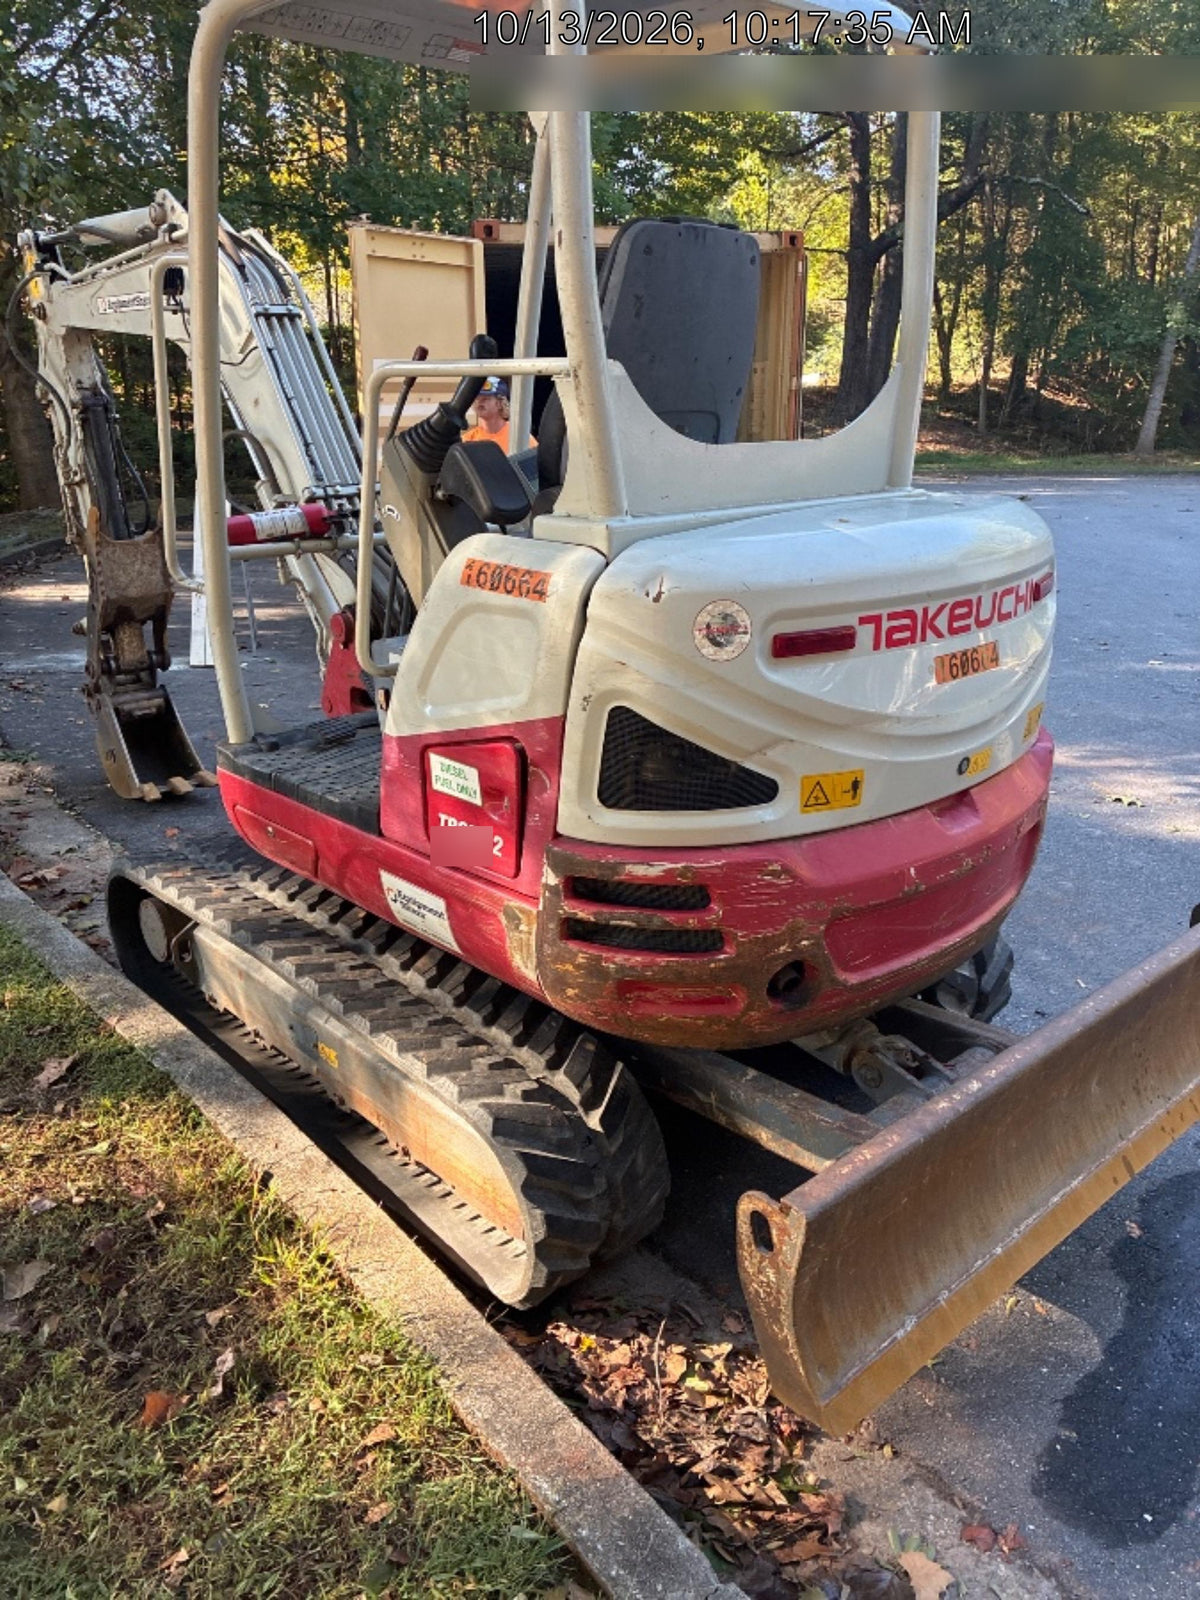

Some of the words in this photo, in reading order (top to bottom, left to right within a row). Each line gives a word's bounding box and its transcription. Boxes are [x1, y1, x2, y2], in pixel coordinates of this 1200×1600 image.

[440, 761, 469, 781] DIESEL
[434, 774, 456, 792] FUEL
[456, 782, 478, 800] ONLY
